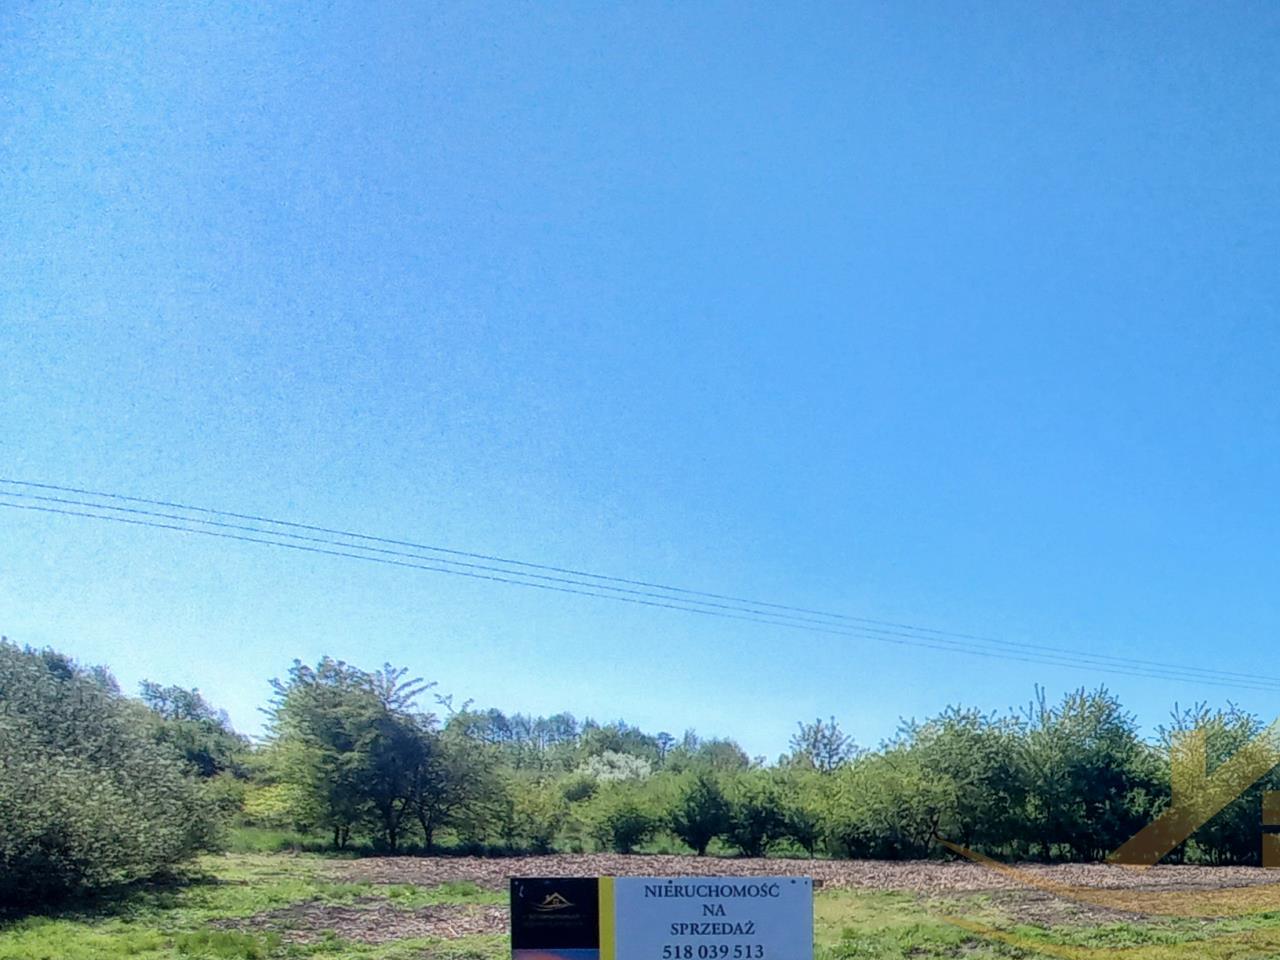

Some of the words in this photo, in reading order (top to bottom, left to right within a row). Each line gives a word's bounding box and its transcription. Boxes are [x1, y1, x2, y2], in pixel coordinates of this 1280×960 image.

[644, 882, 780, 898] NIERUCHOMOŚĆ
[702, 903, 726, 917] NA
[670, 920, 755, 936] SPRZEDAŻ
[662, 944, 693, 960] 518
[698, 944, 729, 960] 039
[733, 944, 764, 960] 513
